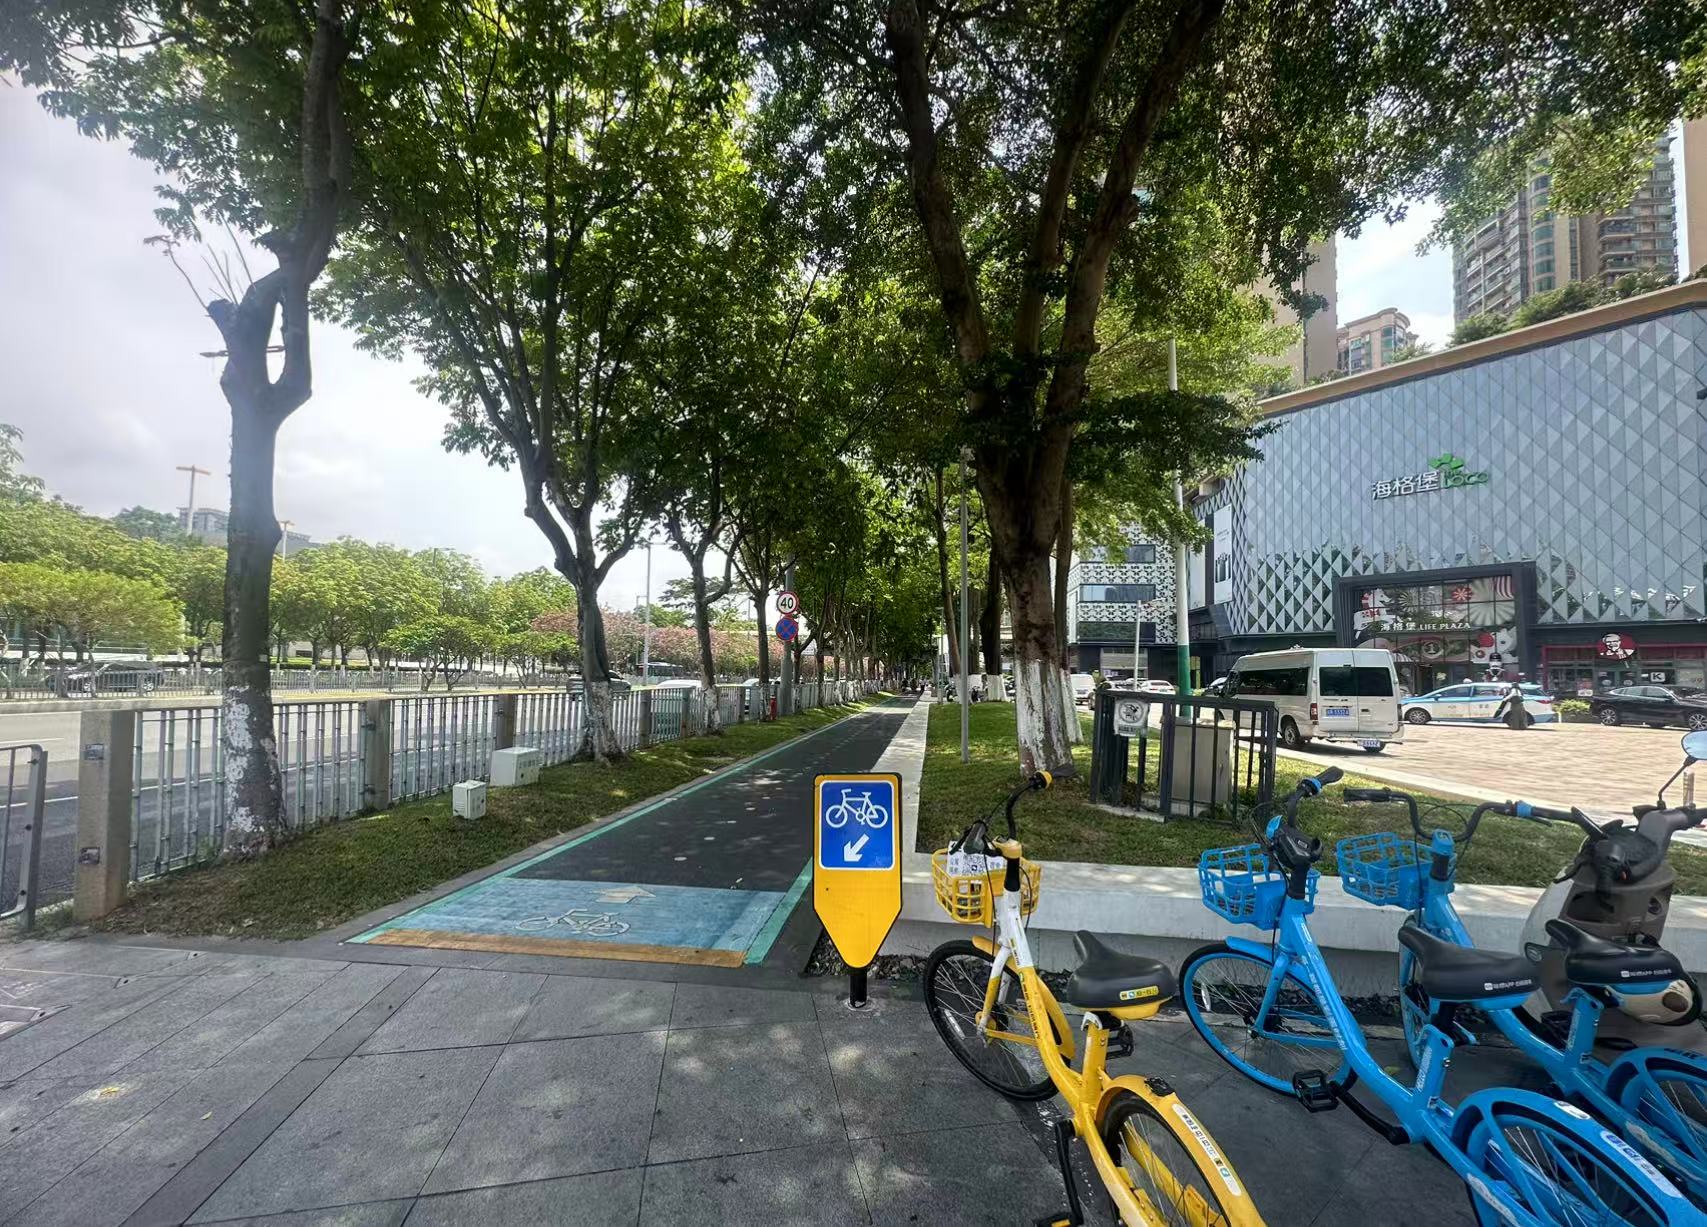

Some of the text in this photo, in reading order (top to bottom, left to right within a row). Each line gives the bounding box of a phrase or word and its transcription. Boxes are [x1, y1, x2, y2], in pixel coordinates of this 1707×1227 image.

[1372, 470, 1440, 499] 海格堡
[780, 598, 794, 609] 40
[1381, 622, 1416, 631] 海格堡
[1440, 622, 1471, 630] PLAZA
